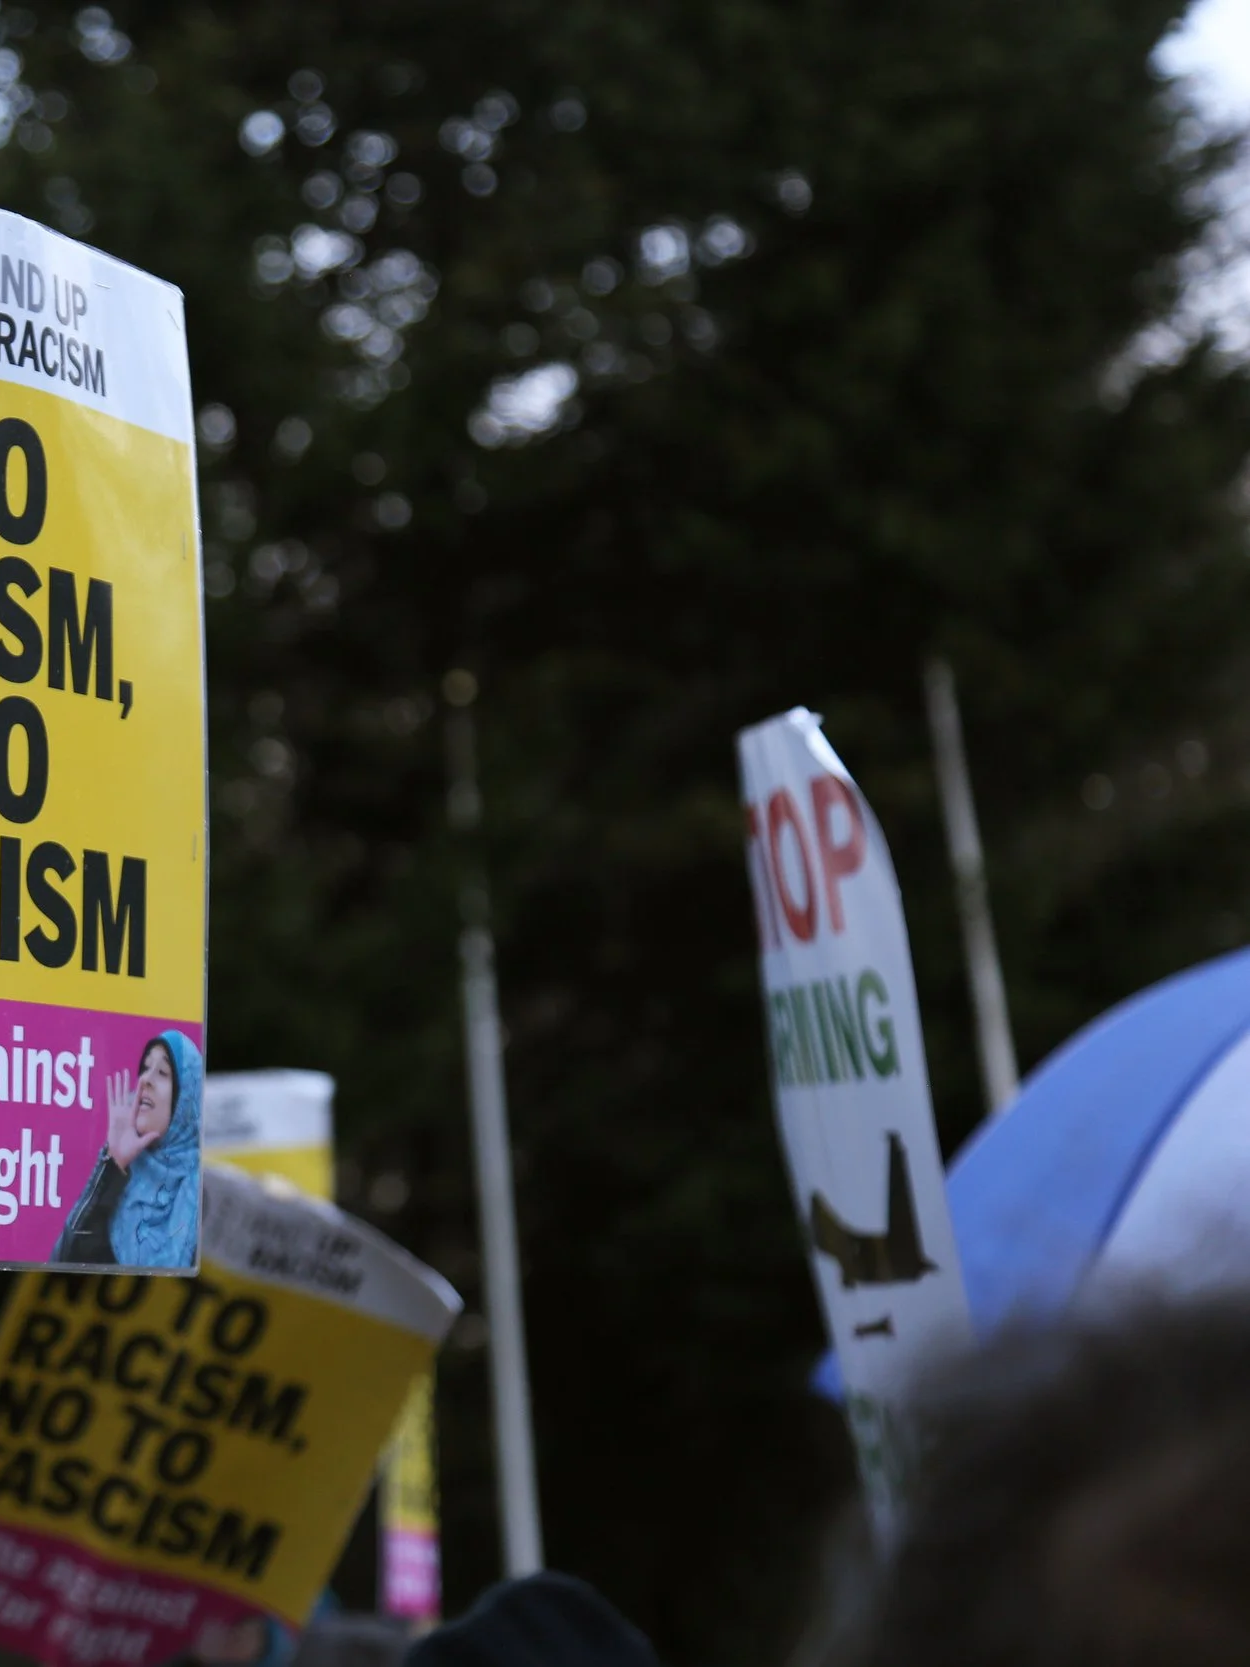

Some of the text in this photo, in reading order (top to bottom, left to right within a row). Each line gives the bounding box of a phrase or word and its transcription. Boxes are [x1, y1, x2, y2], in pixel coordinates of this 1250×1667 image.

[54, 278, 88, 330] UP
[174, 1276, 269, 1358] TO
[117, 1401, 216, 1487] TO
